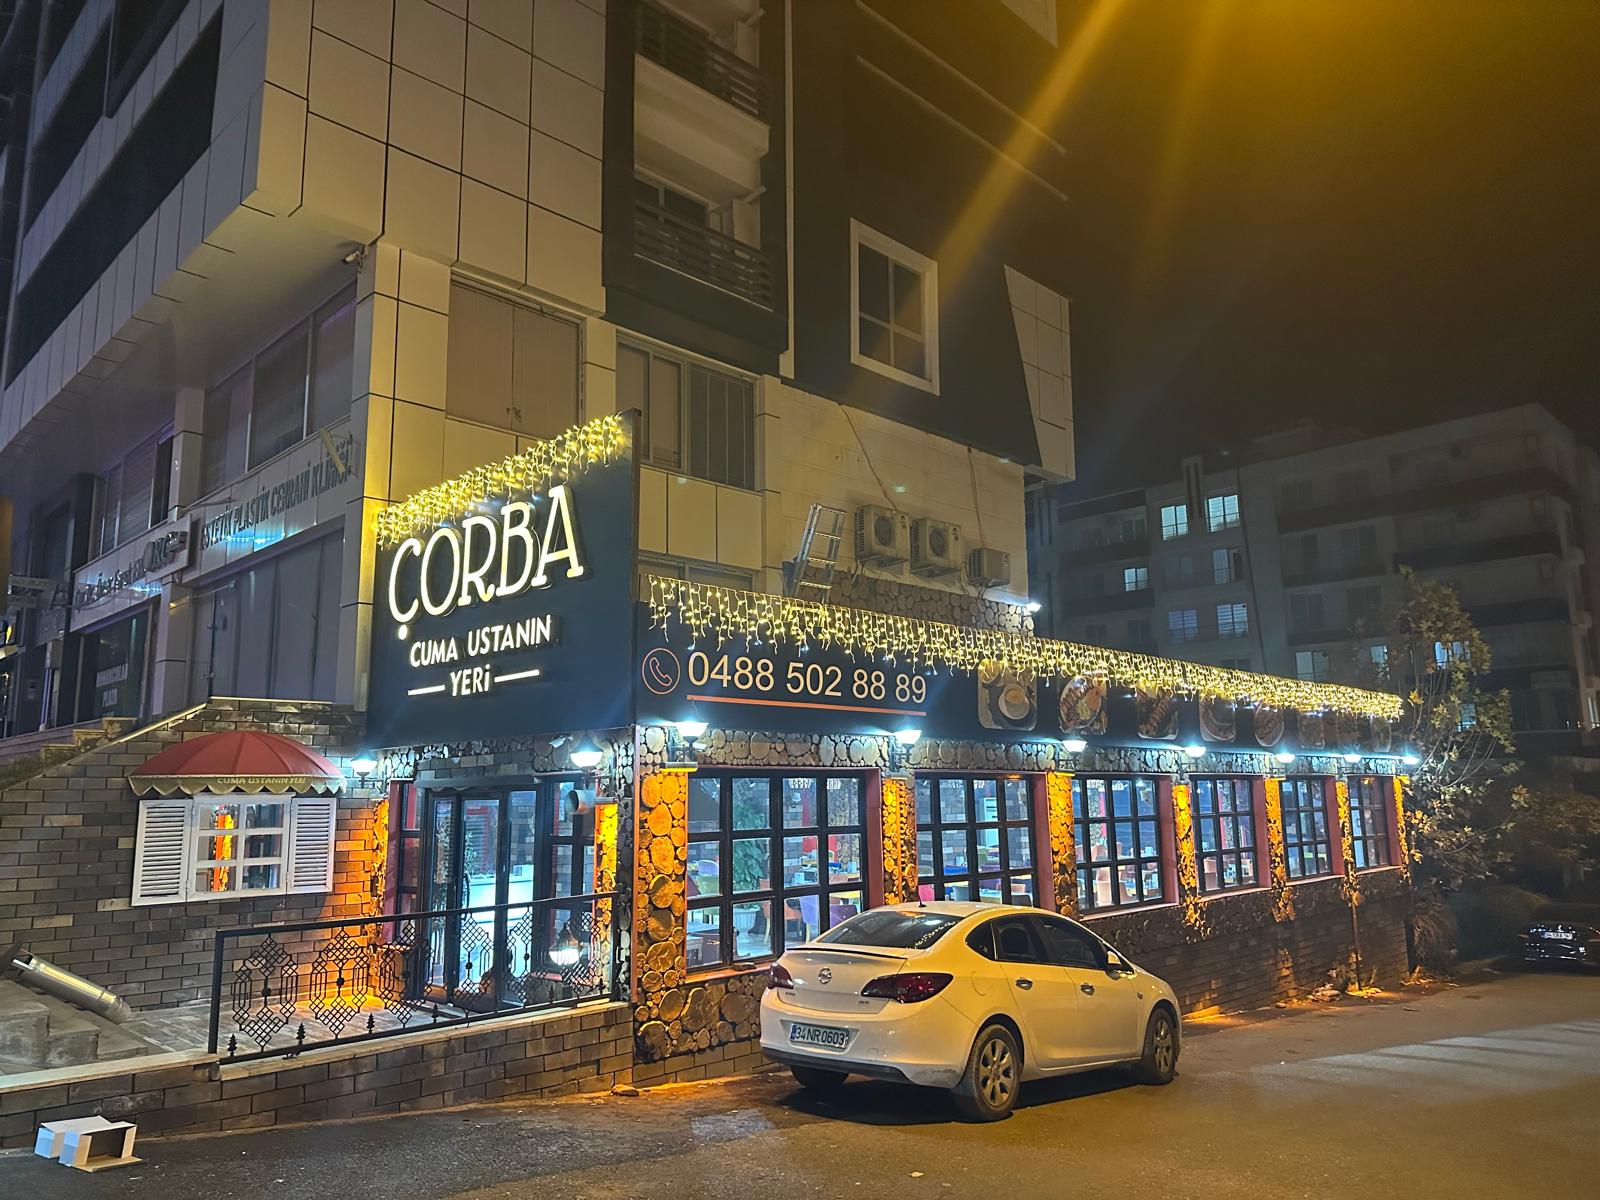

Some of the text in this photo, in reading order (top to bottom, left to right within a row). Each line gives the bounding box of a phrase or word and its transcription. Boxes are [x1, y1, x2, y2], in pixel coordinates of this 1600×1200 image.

[389, 484, 584, 640] ÇORBA
[410, 614, 551, 668] CUMA USTANIN
[688, 651, 927, 704] 0488 502 88 89
